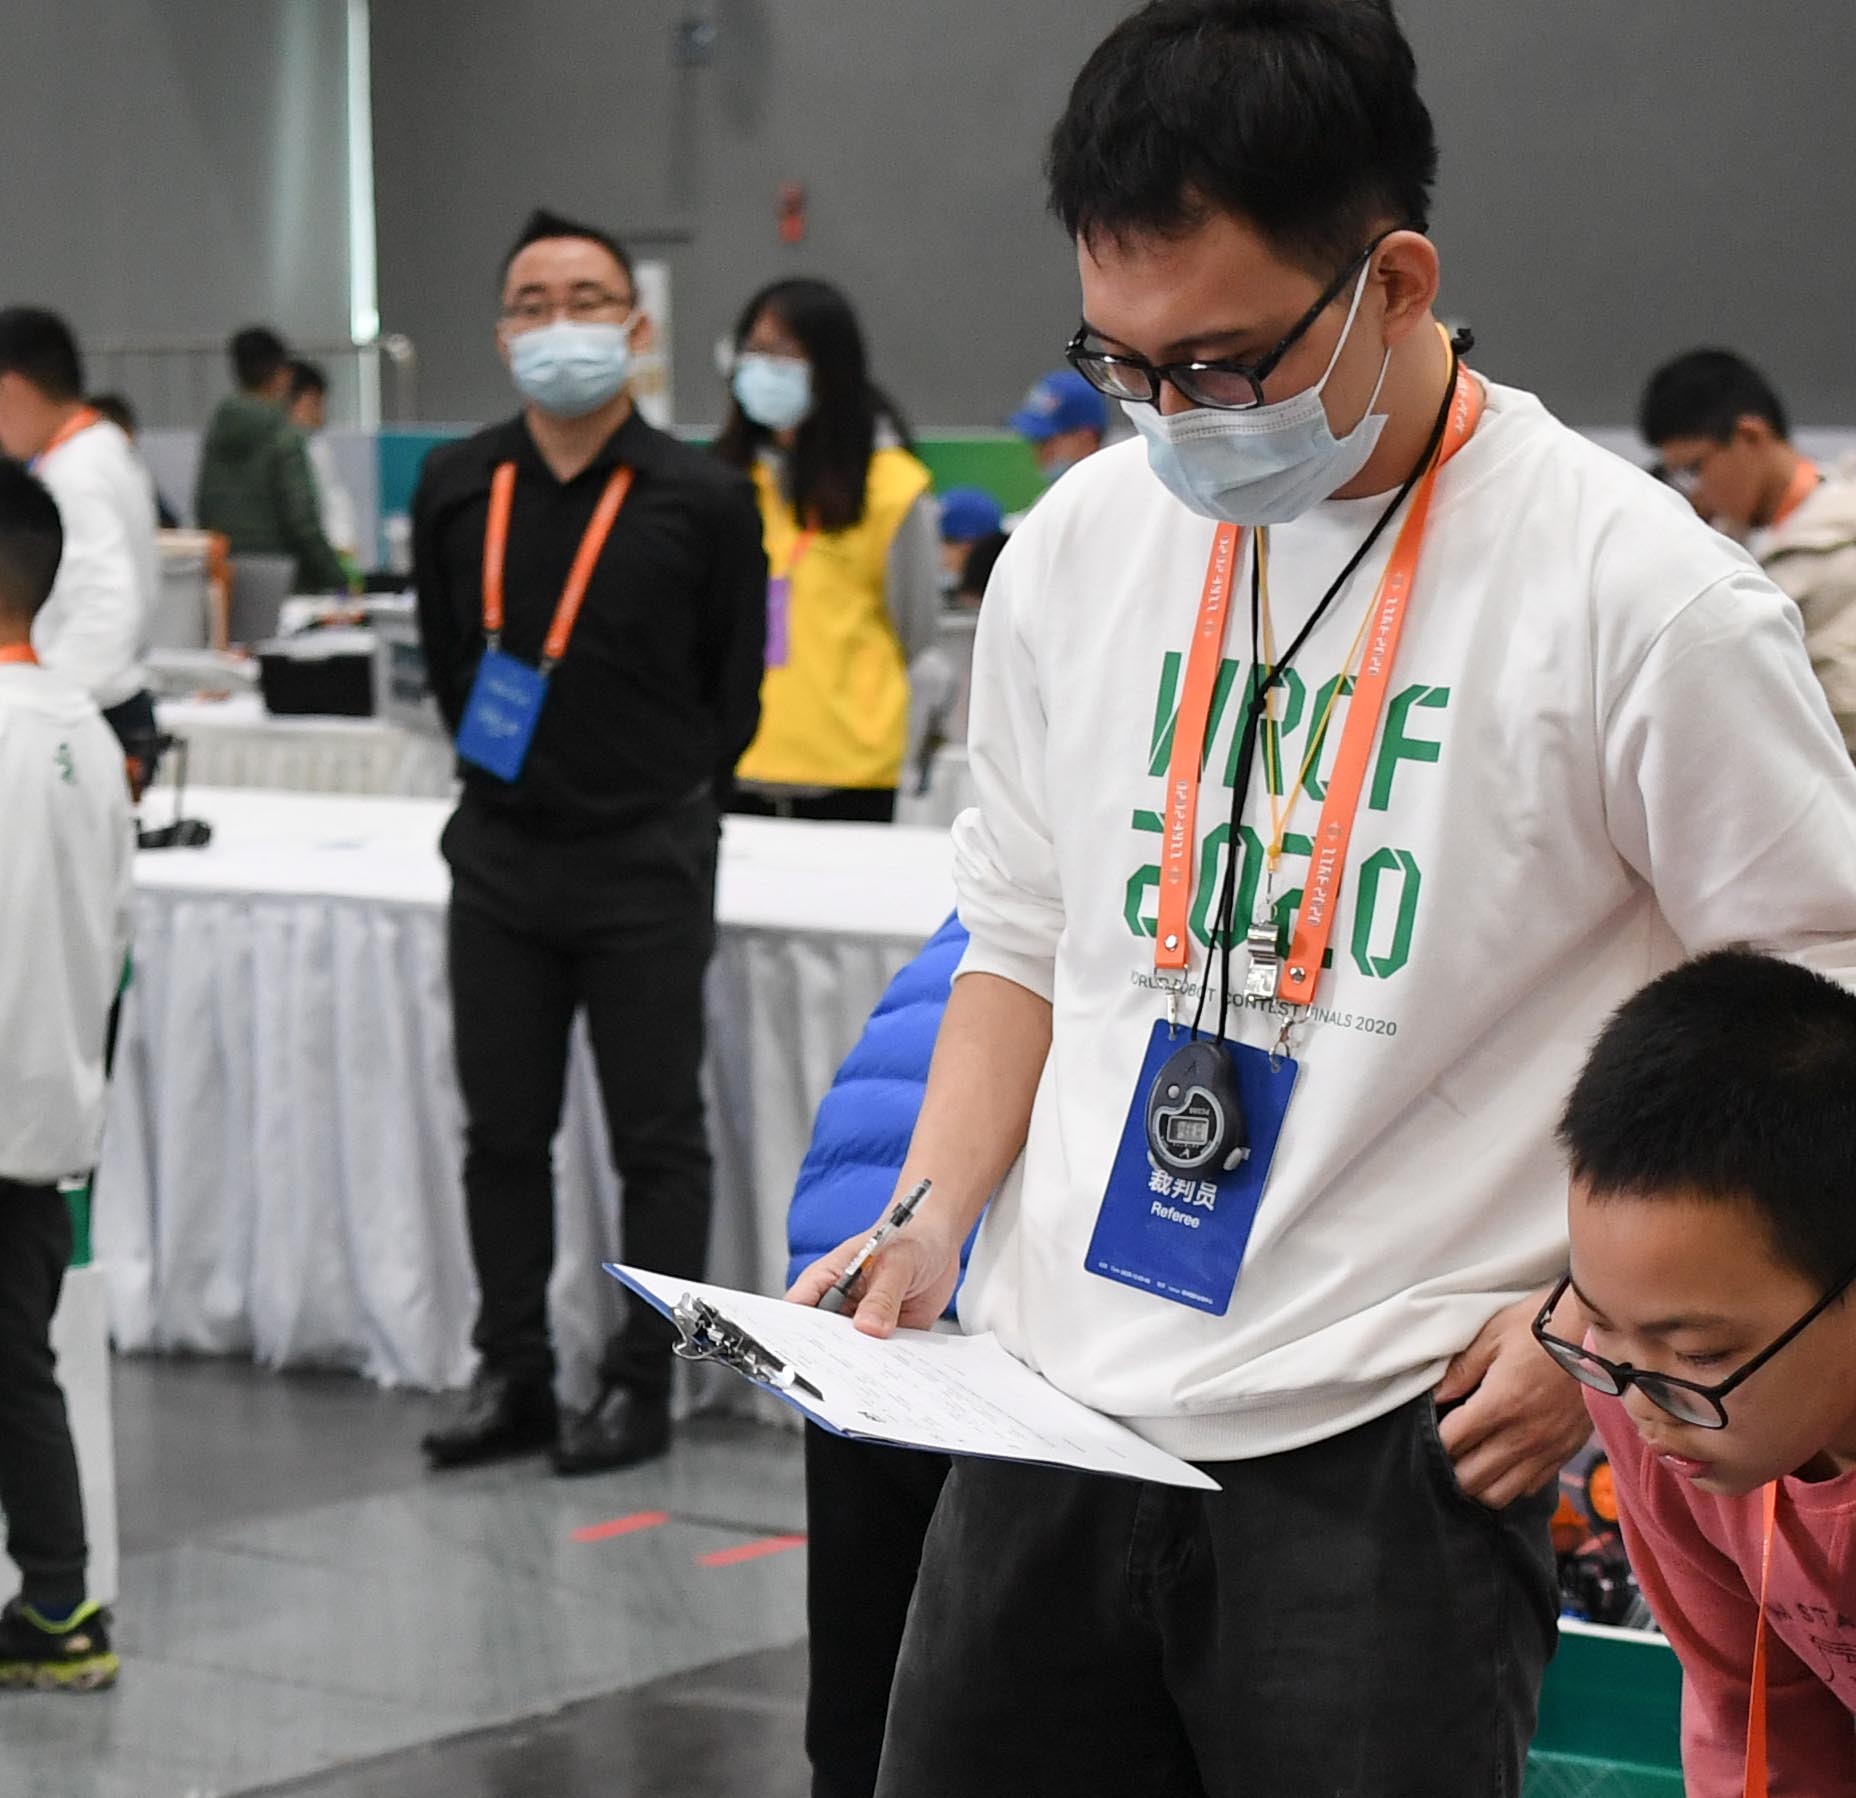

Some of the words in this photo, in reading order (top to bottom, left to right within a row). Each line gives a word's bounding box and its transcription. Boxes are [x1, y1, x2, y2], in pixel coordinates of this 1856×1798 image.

[1356, 1017, 1397, 1037] 2020
[1147, 1168, 1218, 1211] 裁判员
[1150, 1201, 1201, 1230] Referee
